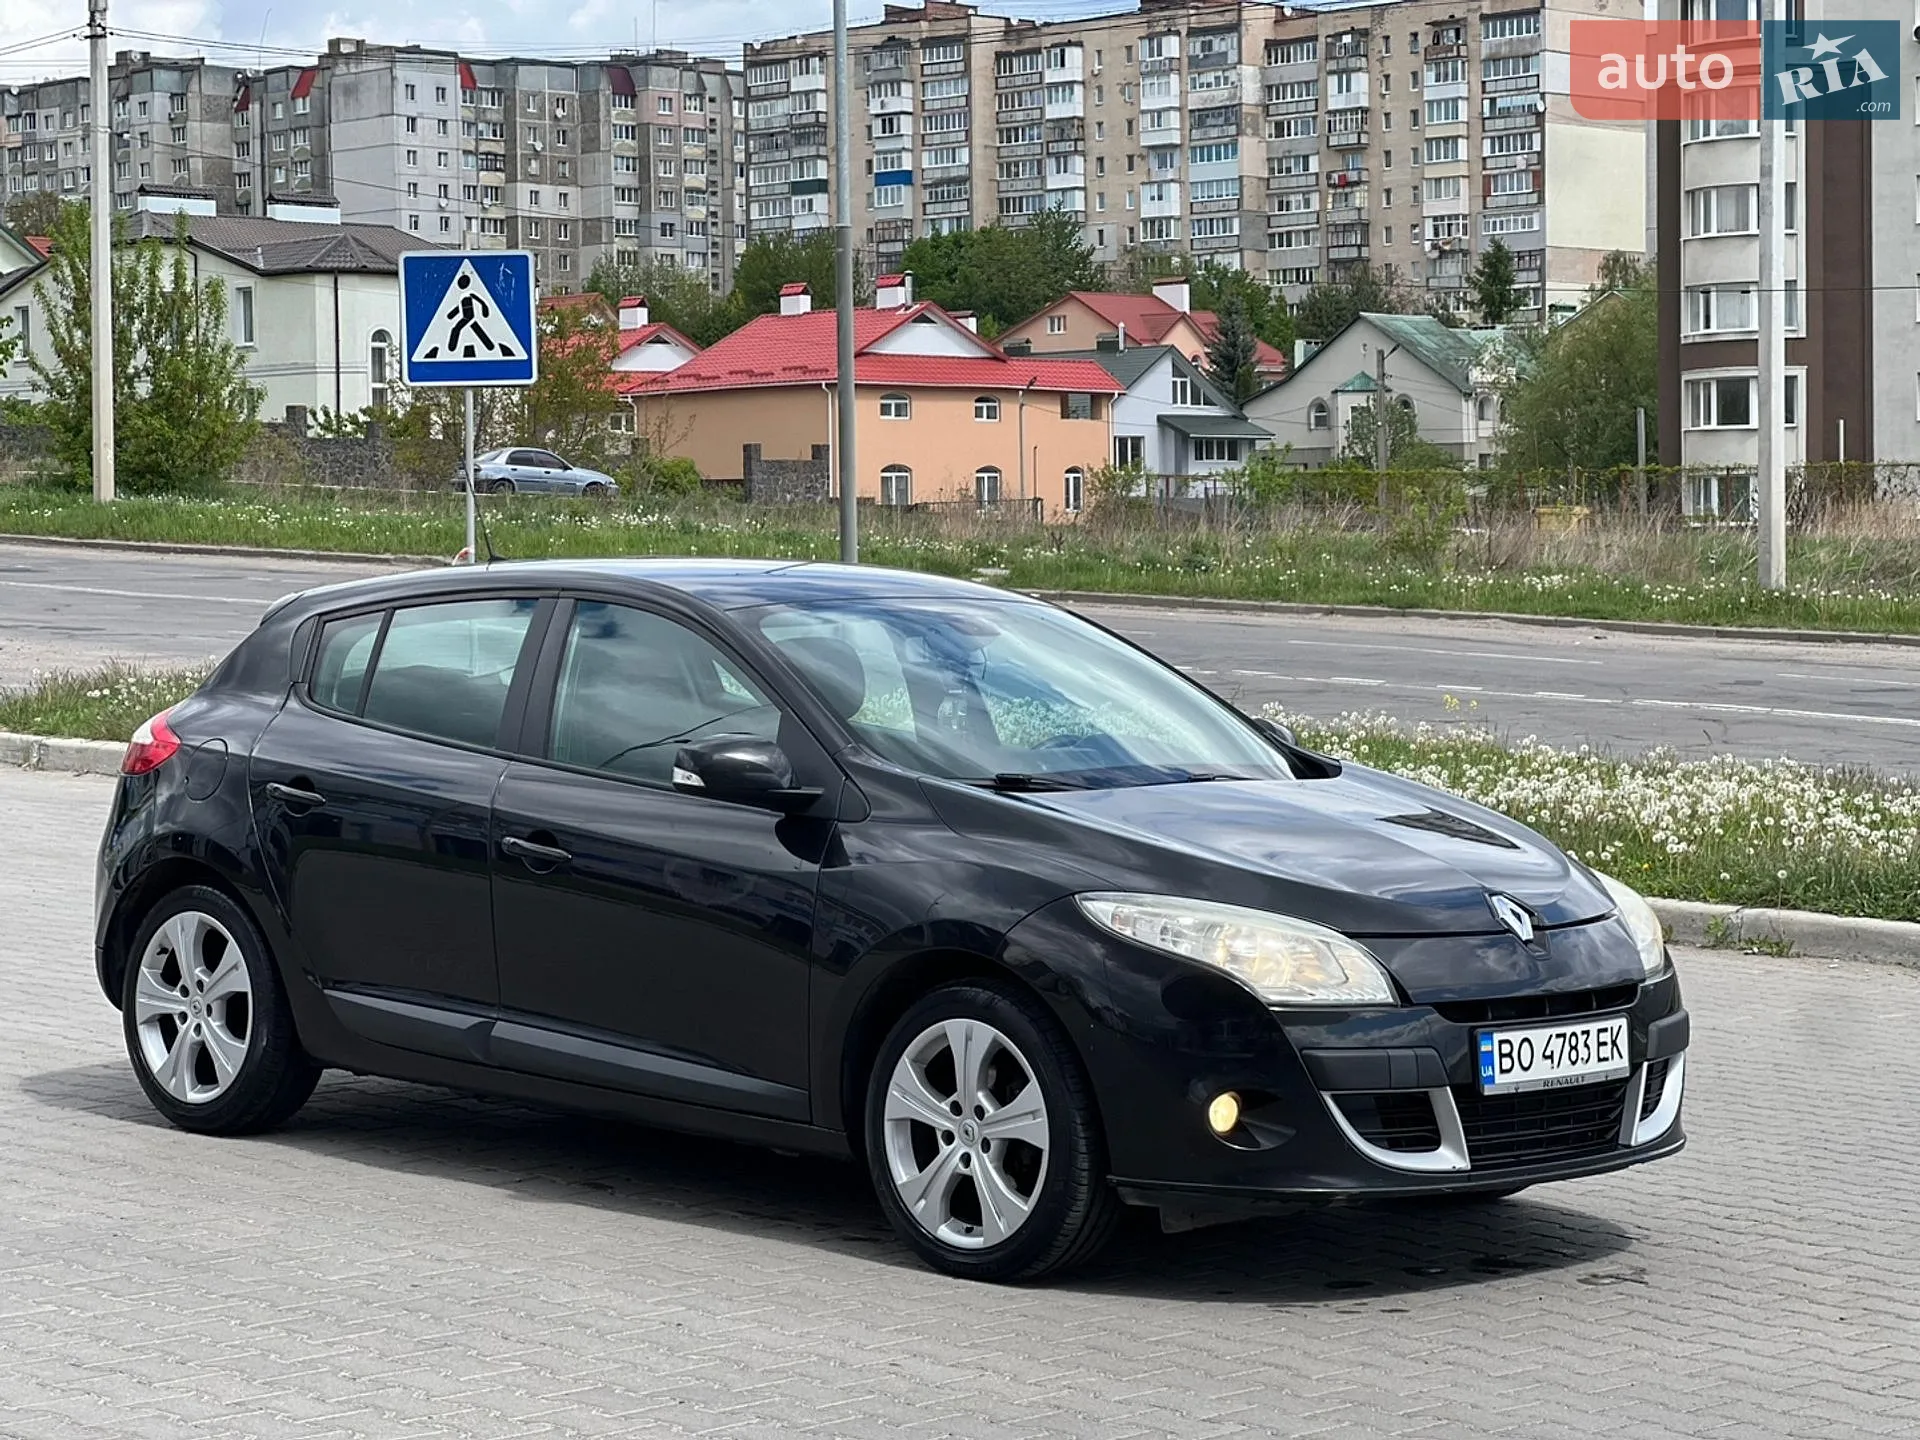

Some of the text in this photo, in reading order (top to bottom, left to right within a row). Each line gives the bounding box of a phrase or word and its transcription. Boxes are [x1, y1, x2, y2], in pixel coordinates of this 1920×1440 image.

[1497, 1024, 1623, 1075] BO 4783 EK
[1481, 1064, 1493, 1077] UA
[1543, 1075, 1585, 1088] RENAULT
